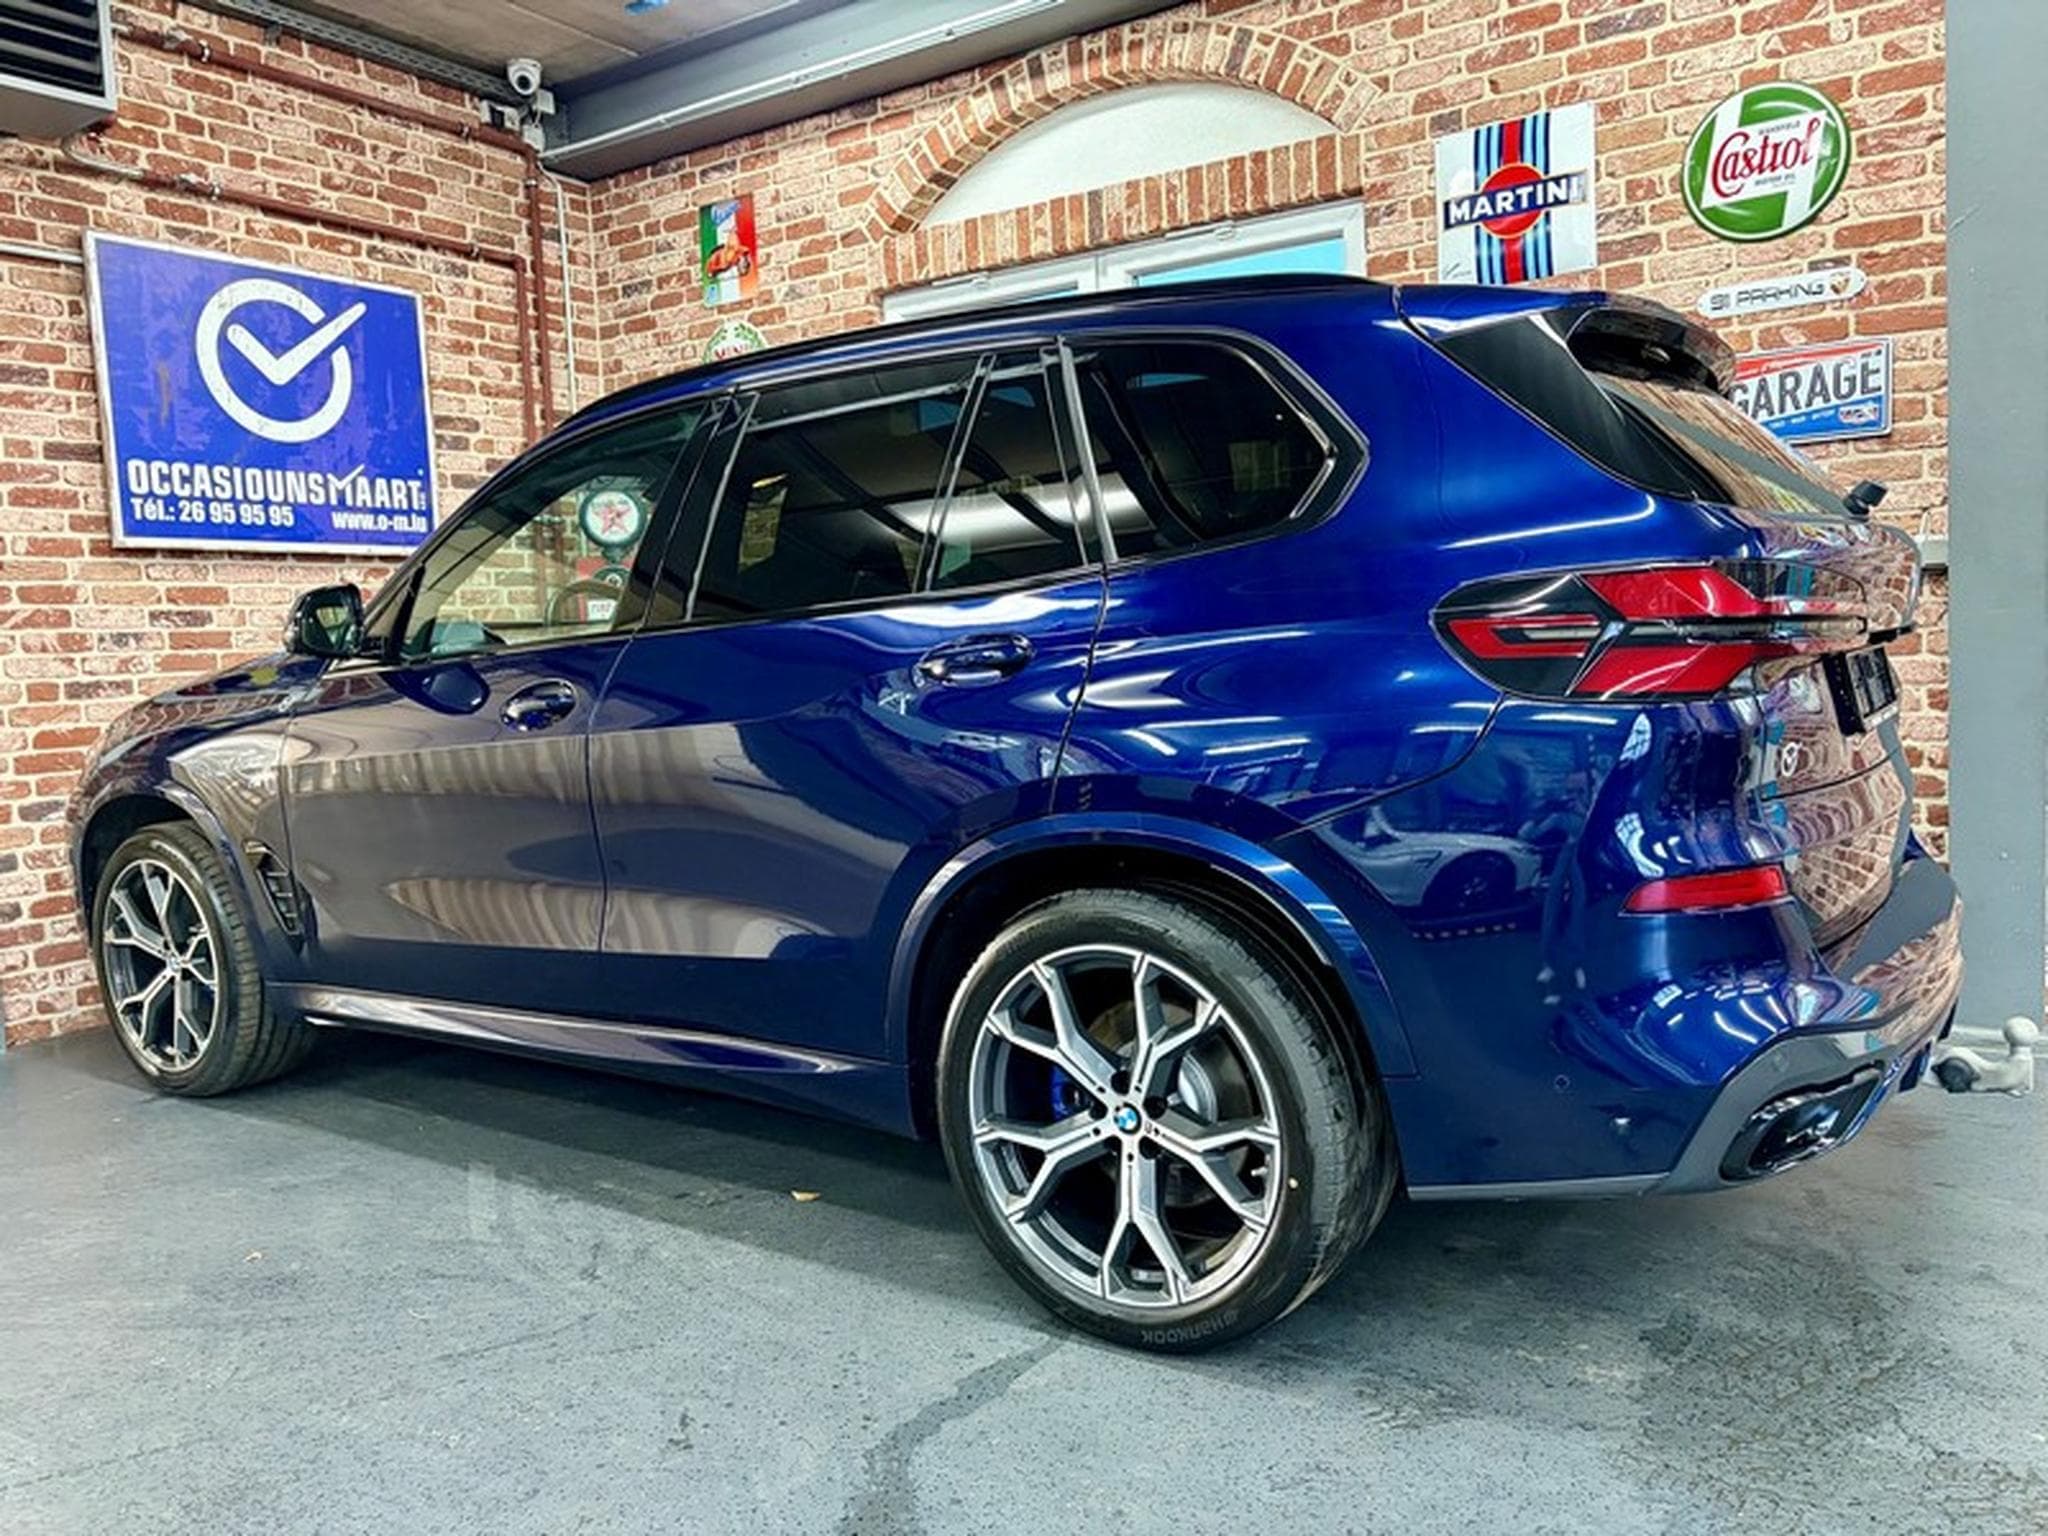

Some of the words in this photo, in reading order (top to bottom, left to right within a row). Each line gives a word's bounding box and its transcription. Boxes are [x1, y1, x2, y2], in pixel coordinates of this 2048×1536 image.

[1712, 117, 1821, 198] Castrol
[1449, 176, 1578, 224] MARTINI
[1736, 282, 1825, 306] PARKING
[1728, 360, 1882, 418] GARAGE
[178, 499, 206, 523] 26
[209, 501, 237, 525] 95
[240, 503, 266, 526] 95
[269, 504, 295, 527] 95
[332, 511, 429, 533] www.o-m.lu
